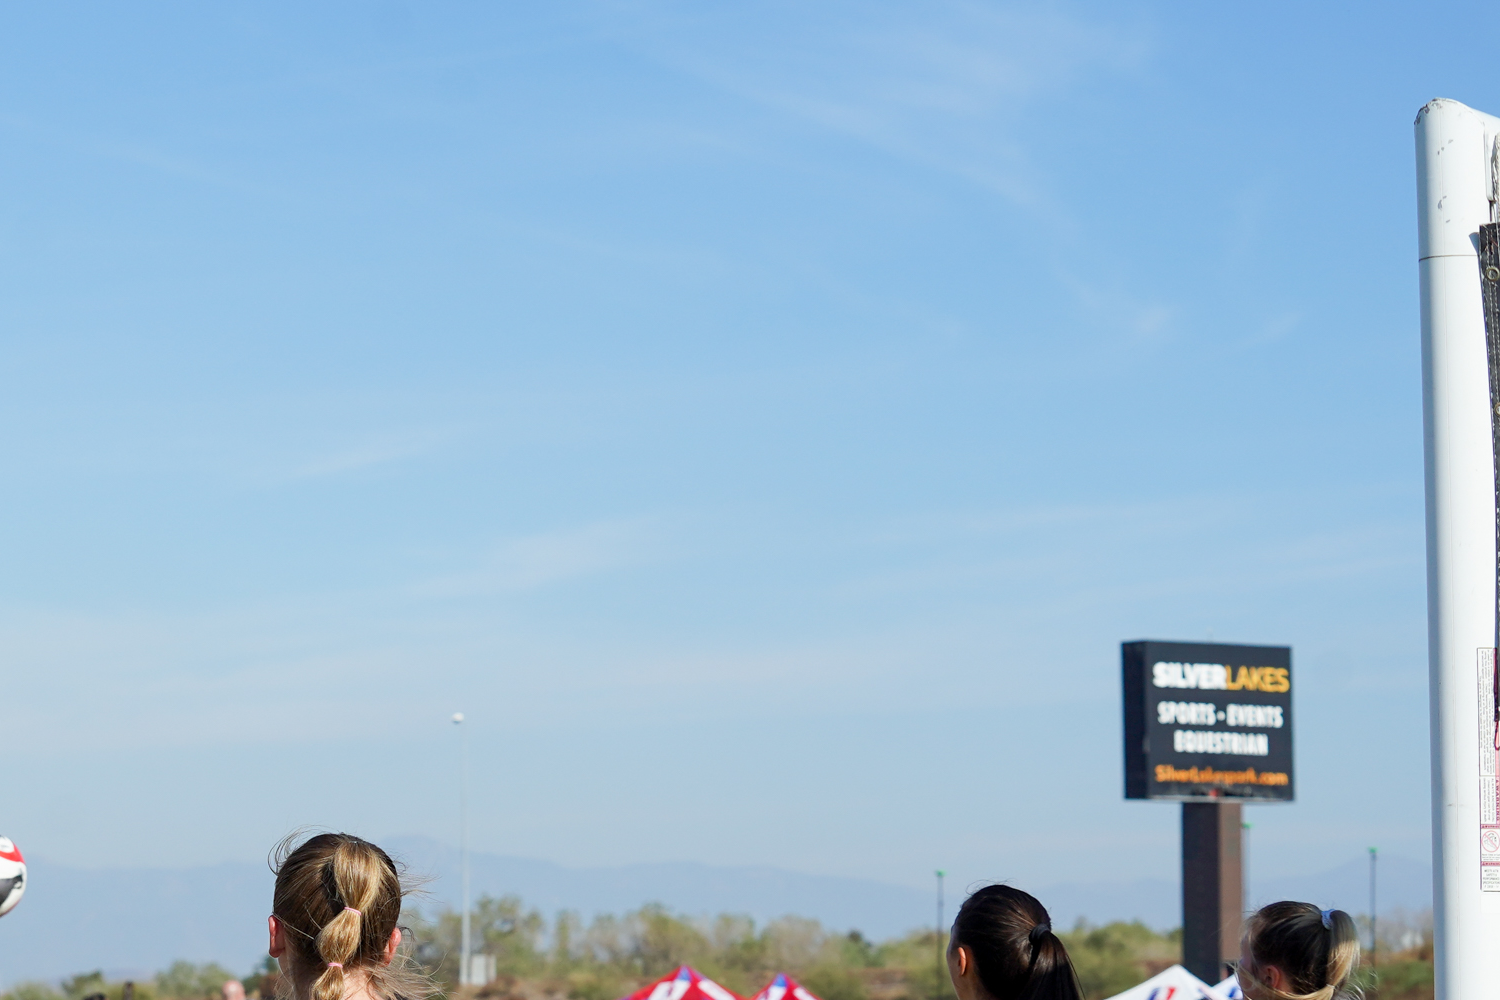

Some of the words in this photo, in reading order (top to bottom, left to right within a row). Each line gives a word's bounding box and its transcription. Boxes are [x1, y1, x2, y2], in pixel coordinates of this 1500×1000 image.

[1152, 661, 1290, 693] SILVERLAKES
[1157, 701, 1216, 726] SPORTS
[1226, 703, 1284, 728] EVENTS
[1173, 730, 1268, 756] EQUESTRIAN
